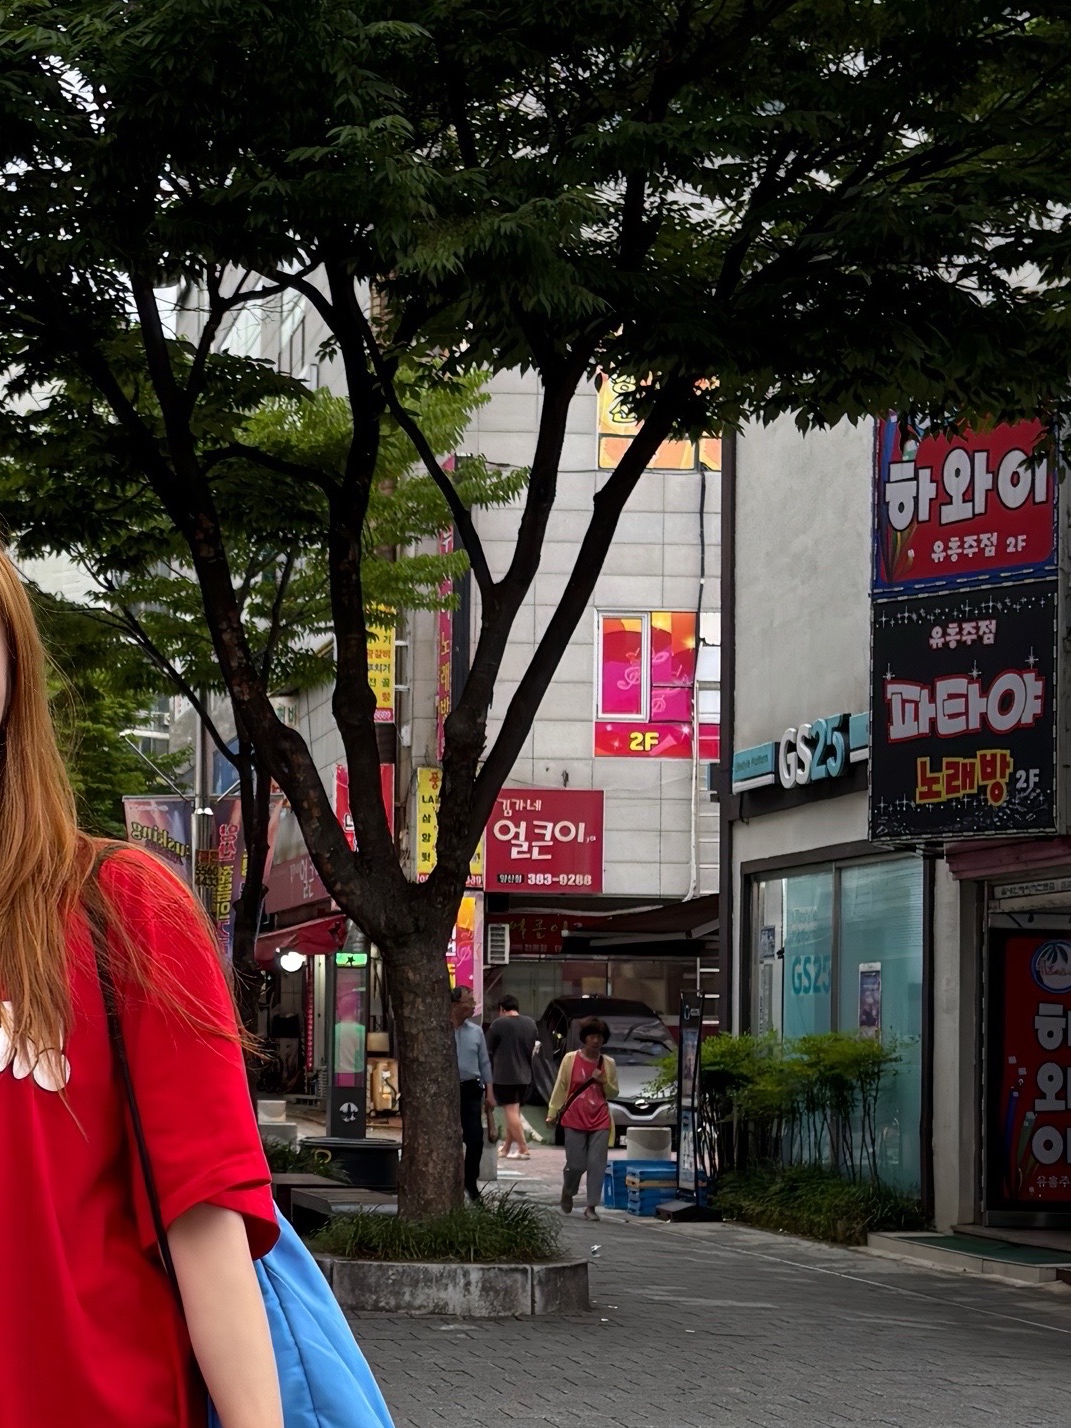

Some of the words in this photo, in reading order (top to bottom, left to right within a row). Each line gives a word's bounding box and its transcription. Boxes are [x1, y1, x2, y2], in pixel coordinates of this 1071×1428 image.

[884, 447, 1048, 531] 하와이
[931, 532, 997, 563] 유흥주점
[1006, 535, 1027, 554] 2F
[929, 619, 997, 650] 유흥주점
[885, 669, 1045, 744] 파타야
[629, 731, 660, 751] 2F
[779, 714, 850, 790] GS25
[916, 749, 1013, 807] 노래방
[1015, 768, 1039, 790] 2F
[497, 799, 542, 817] 김가네
[493, 819, 586, 860] 얼큰이
[792, 955, 831, 995] GS25
